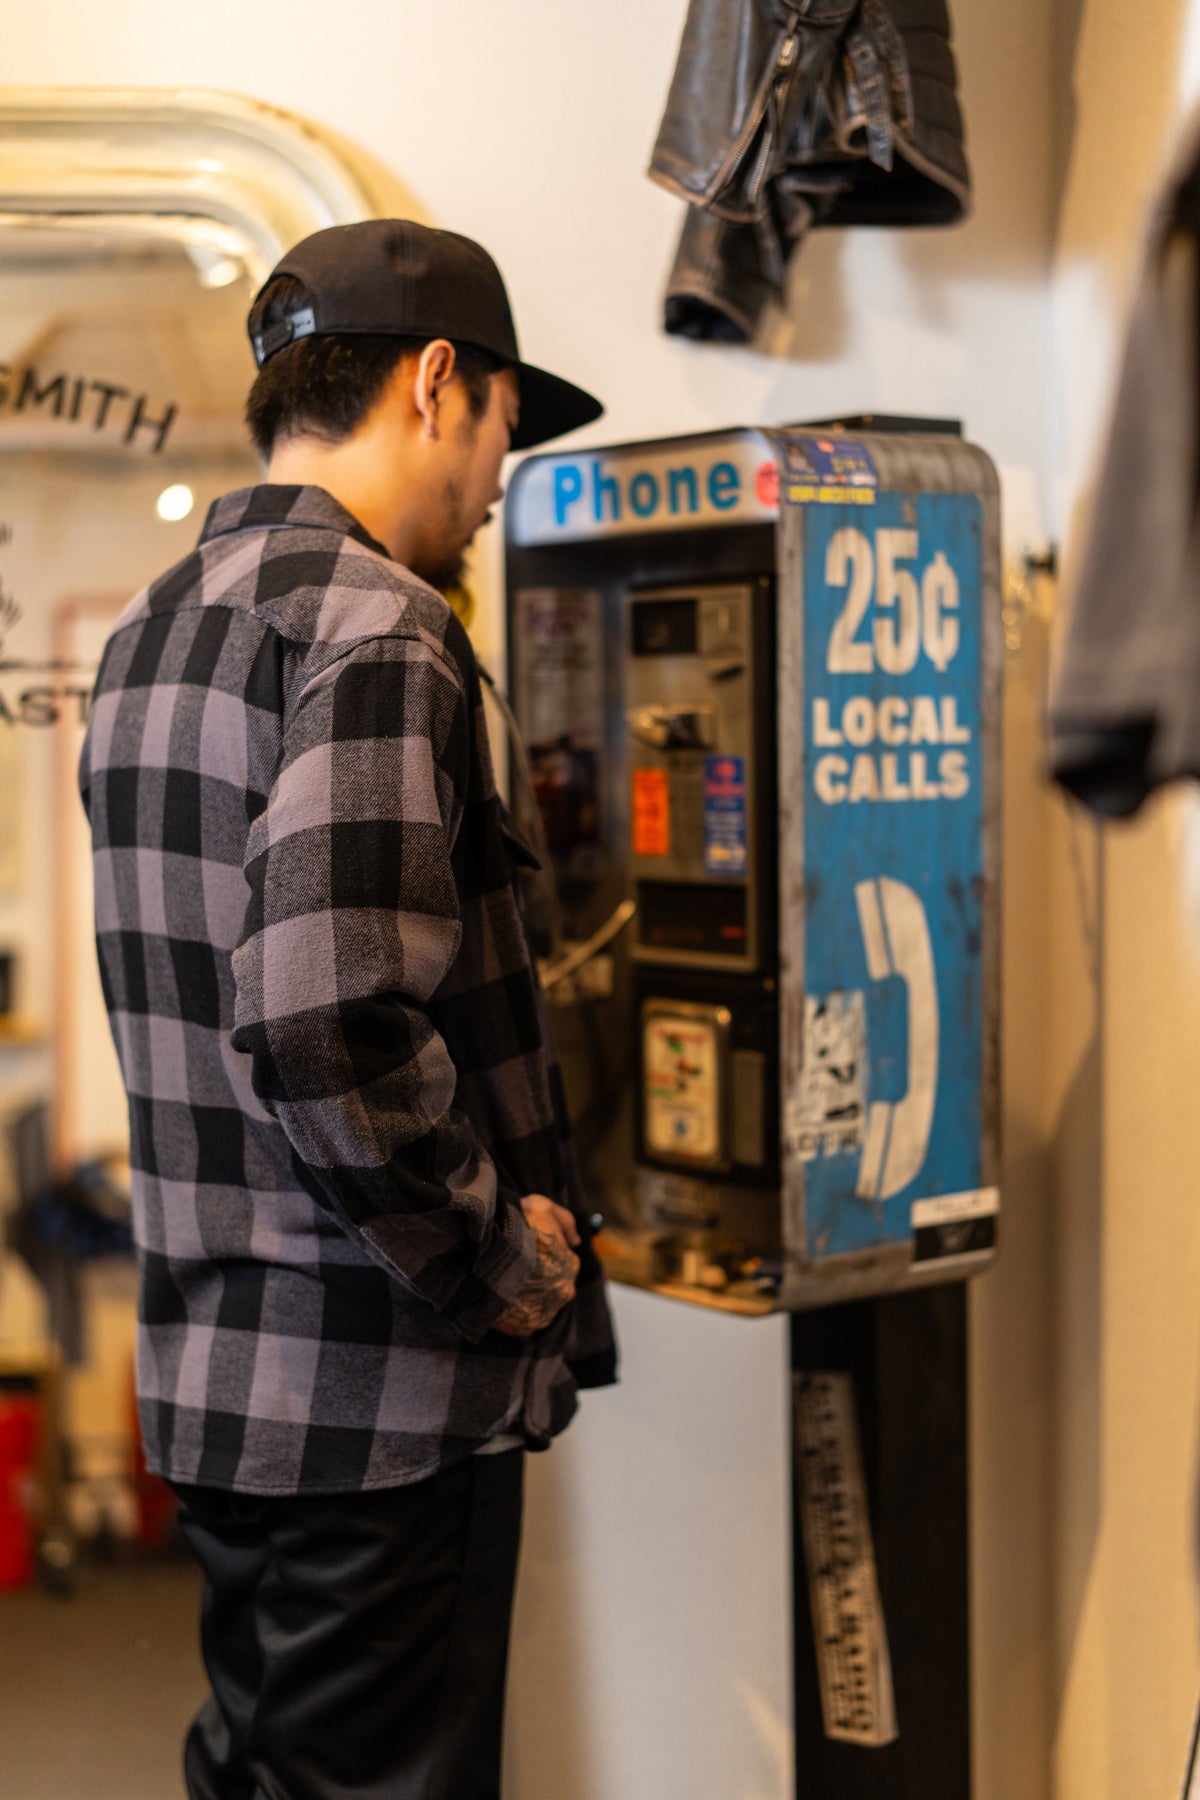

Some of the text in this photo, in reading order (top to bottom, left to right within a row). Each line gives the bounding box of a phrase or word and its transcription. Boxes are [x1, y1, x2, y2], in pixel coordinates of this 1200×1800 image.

[551, 459, 742, 526] Phone
[825, 527, 960, 675] 25¢
[813, 696, 970, 747] LOCAL
[813, 751, 971, 804] CALLS
